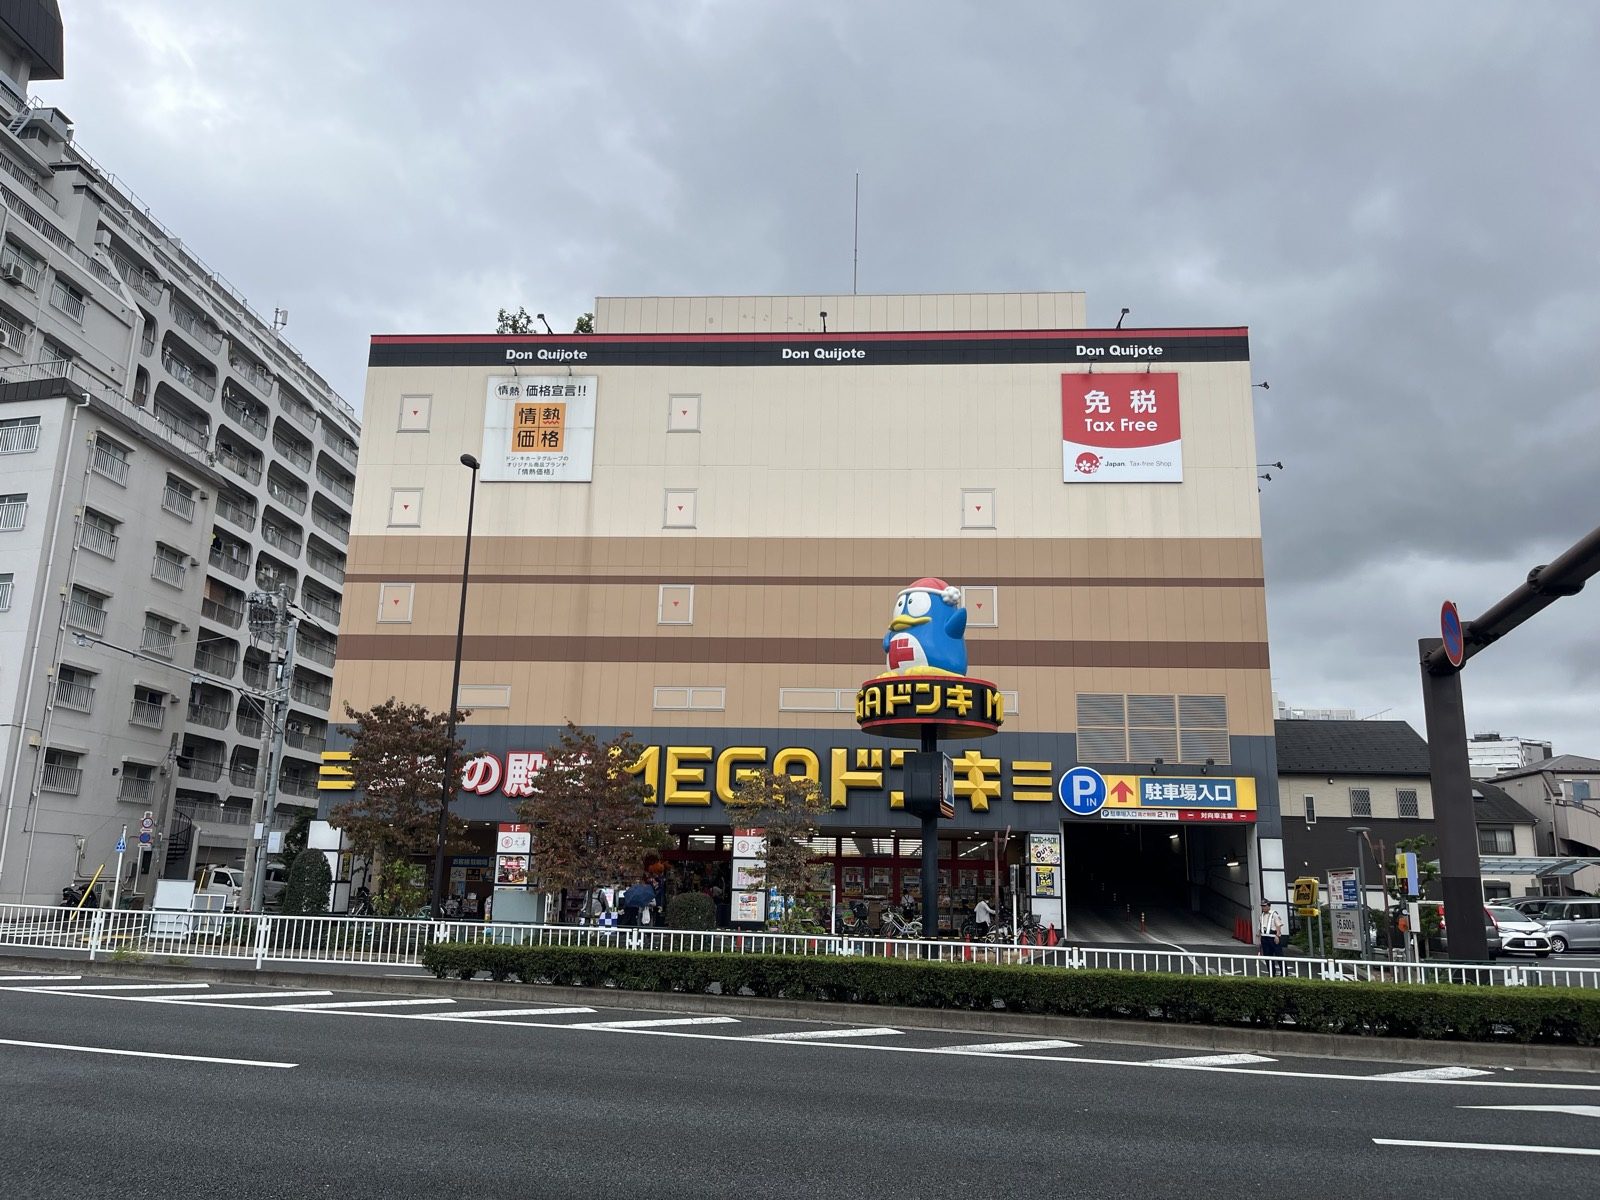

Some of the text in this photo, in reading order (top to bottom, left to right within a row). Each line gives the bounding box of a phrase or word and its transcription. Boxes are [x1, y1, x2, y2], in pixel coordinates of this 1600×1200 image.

[506, 349, 588, 361] Don Quijote
[782, 348, 866, 360] Don Quijote
[1076, 345, 1163, 357] Don Quijote
[497, 385, 519, 396] 情熱
[1084, 389, 1157, 413] 免税
[518, 407, 560, 424] 情熱
[1085, 418, 1158, 432] Tax Free
[517, 430, 559, 448] 価格
[1155, 460, 1172, 468] Shop
[888, 638, 914, 670] ド
[1072, 775, 1097, 807] P
[1145, 783, 1231, 801] 駐車場入口
[1086, 797, 1097, 807] IN
